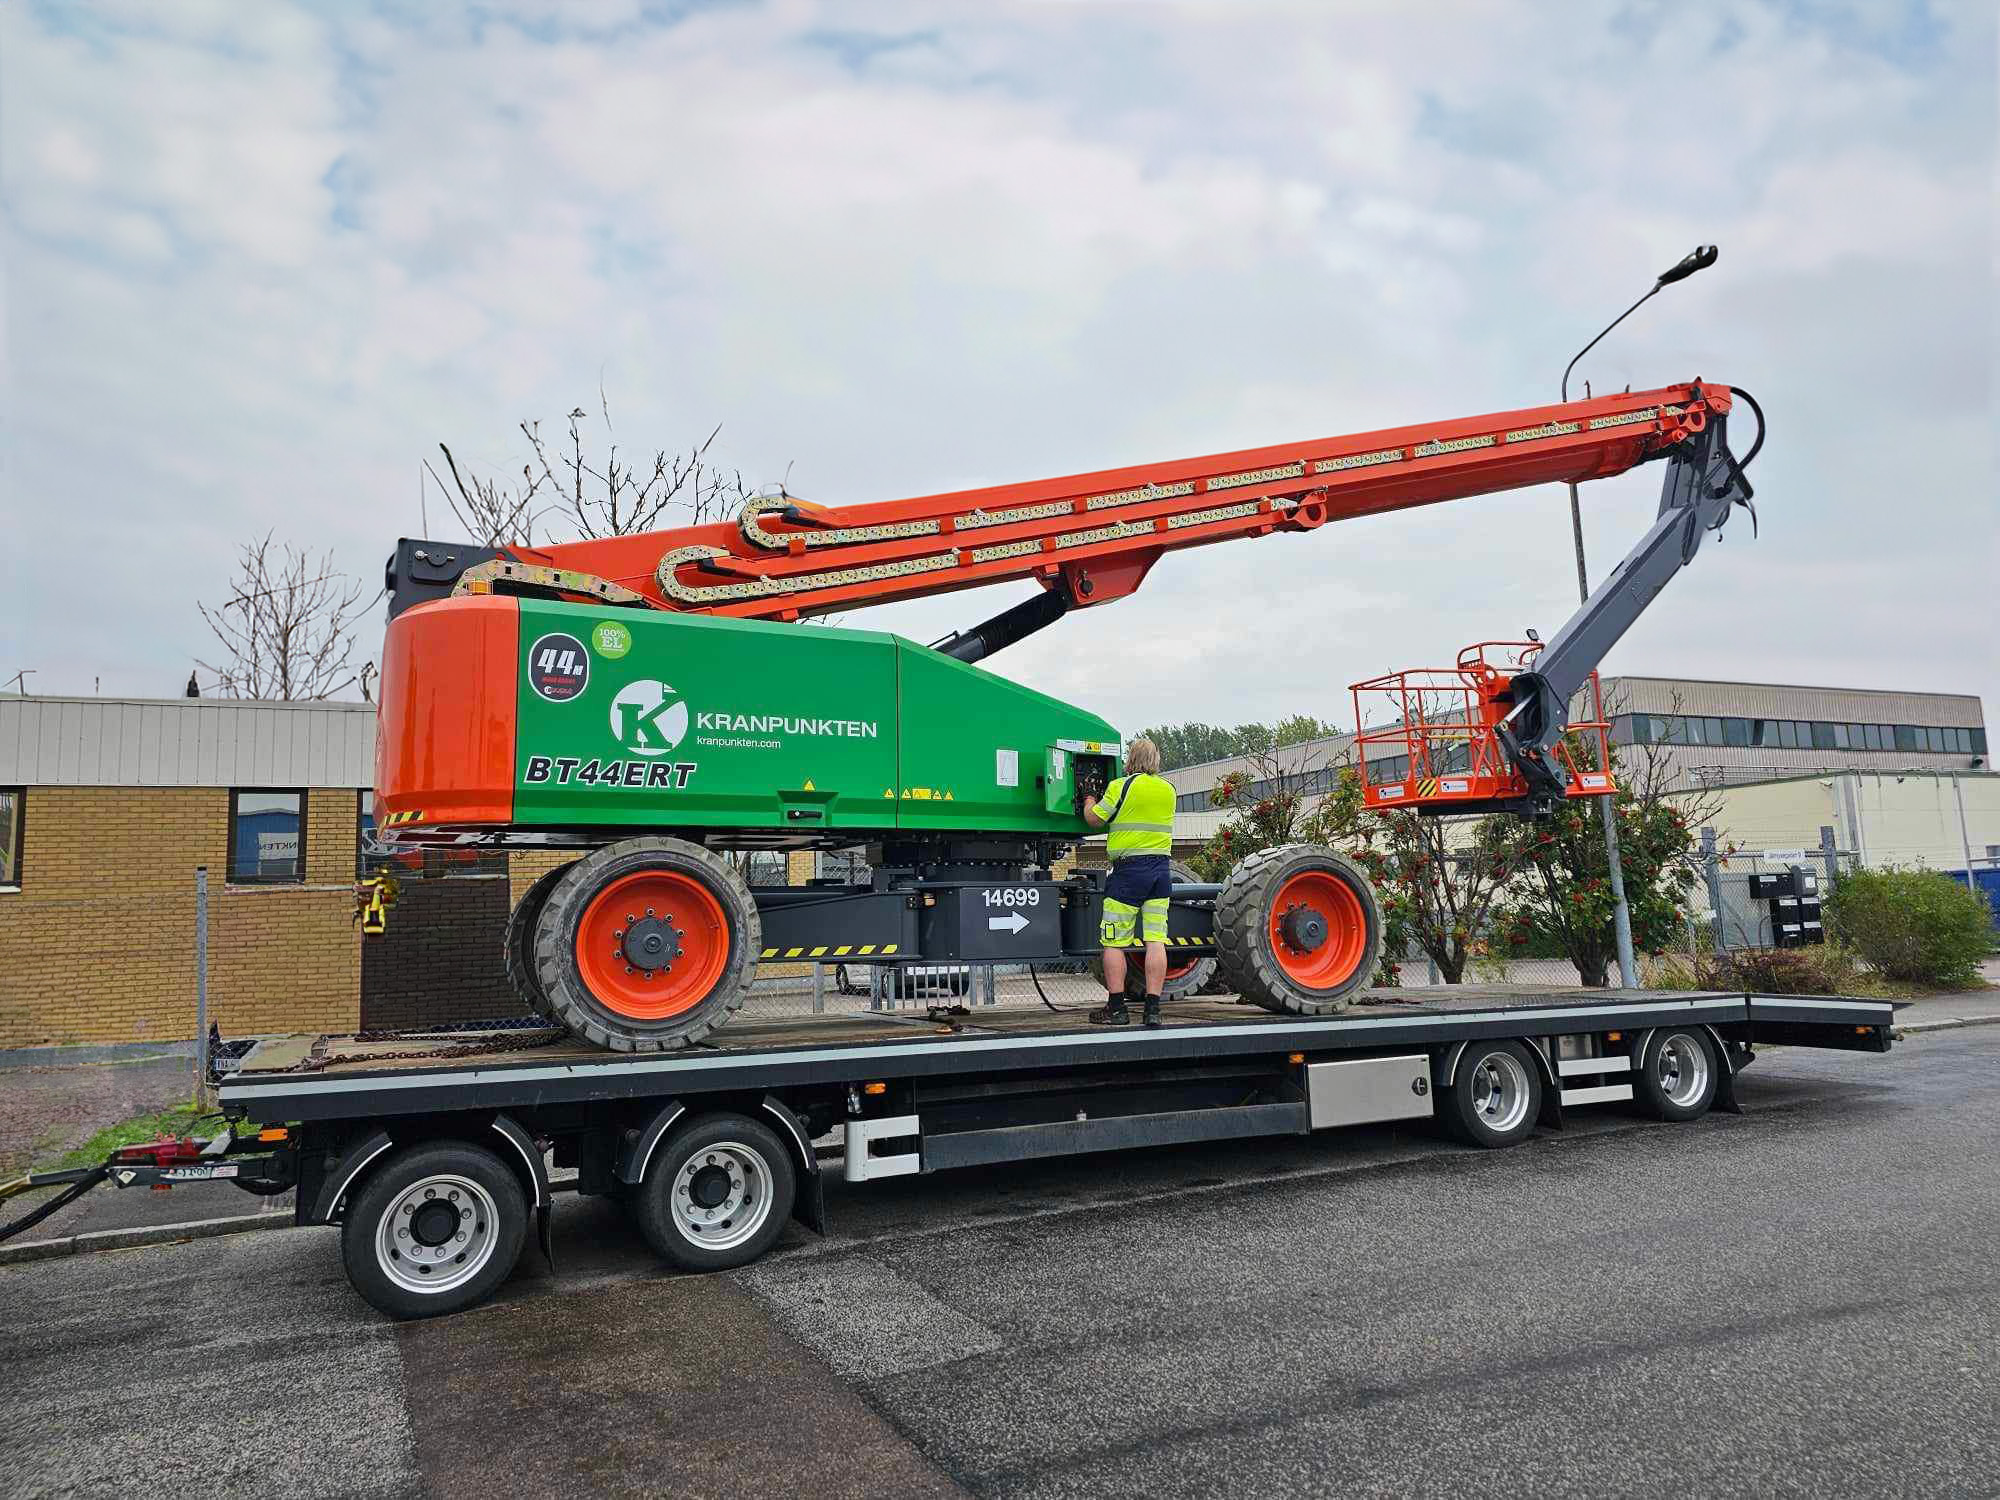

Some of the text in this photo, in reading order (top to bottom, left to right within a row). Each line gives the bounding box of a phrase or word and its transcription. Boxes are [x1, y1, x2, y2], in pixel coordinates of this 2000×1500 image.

[601, 636, 623, 648] EL
[697, 712, 877, 738] KRANPUNKTEN
[697, 736, 781, 749] kranpunkten.com
[524, 756, 697, 789] BT44ERT
[982, 888, 1040, 906] 14699
